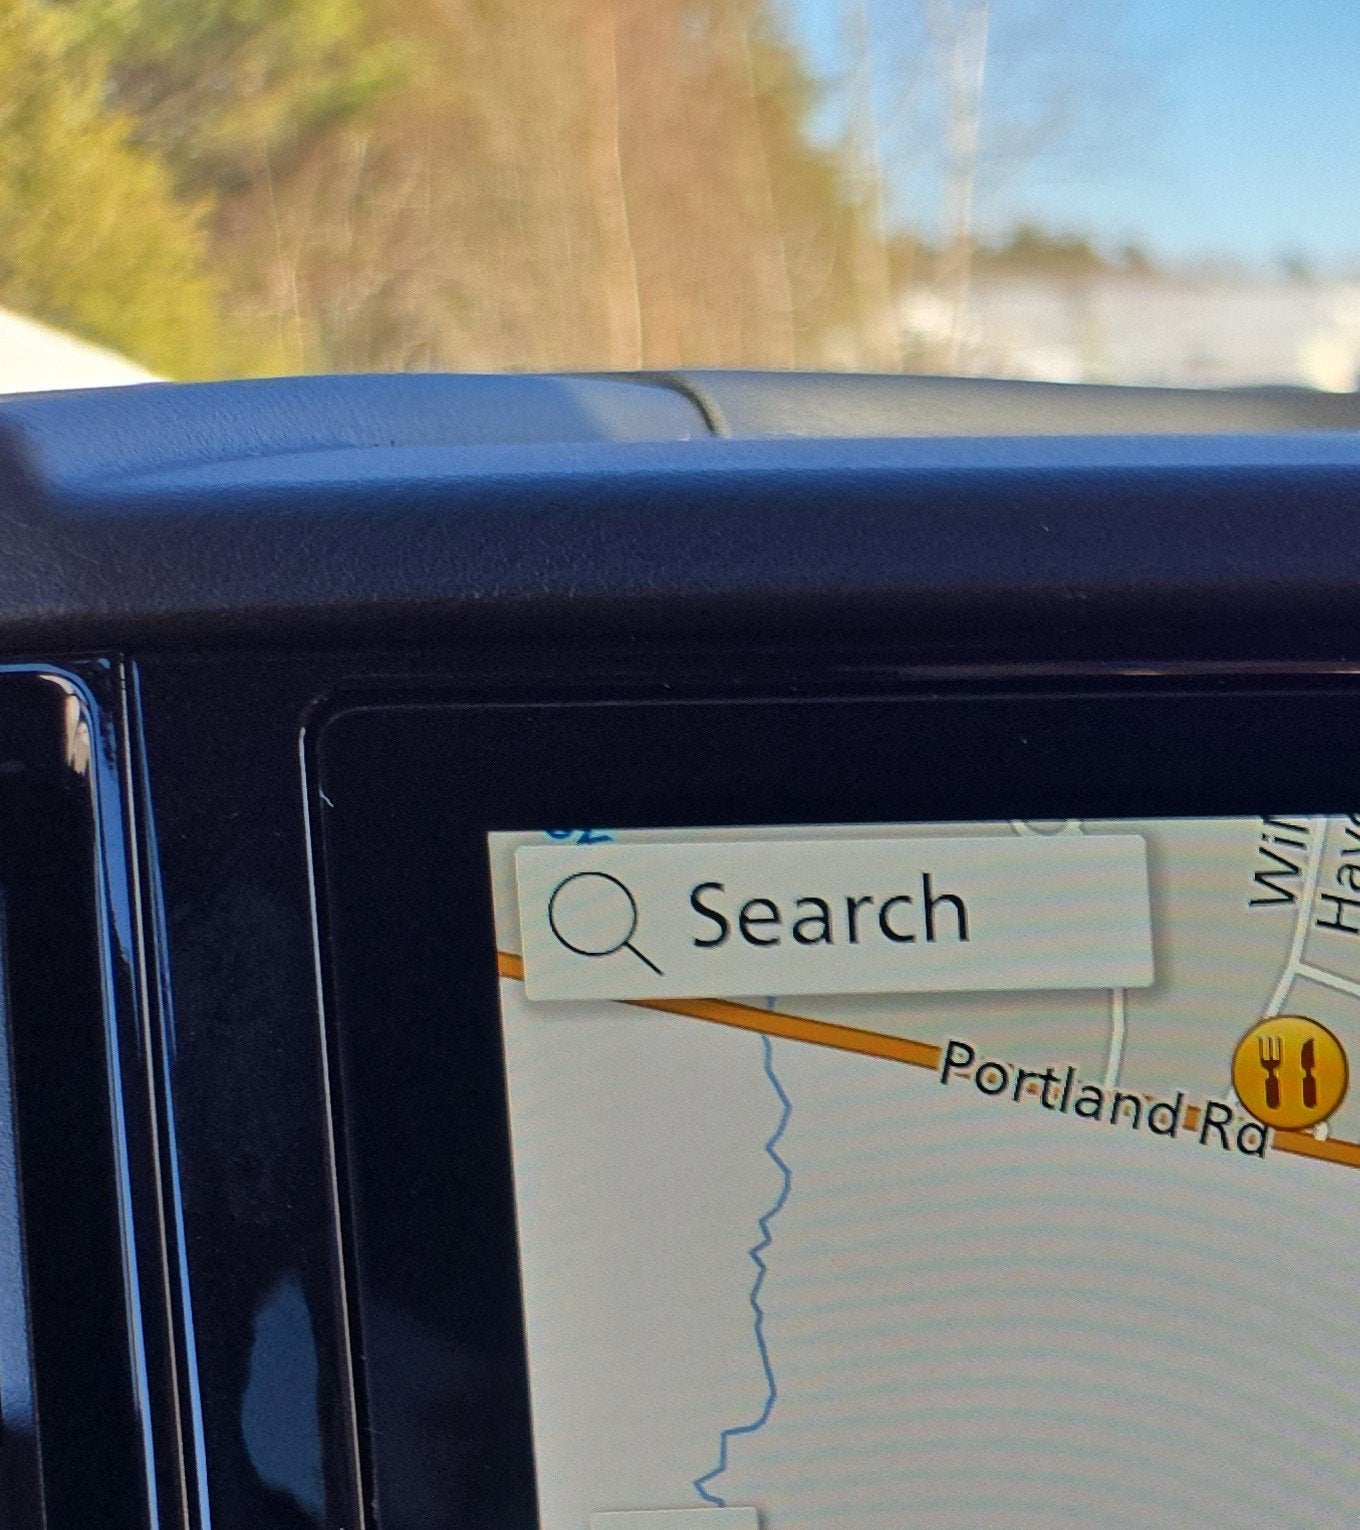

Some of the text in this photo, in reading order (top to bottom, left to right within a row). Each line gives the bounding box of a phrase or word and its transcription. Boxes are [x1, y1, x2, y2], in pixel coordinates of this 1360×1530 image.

[689, 872, 970, 948] Search
[940, 1040, 1269, 1158] Portland Rd
